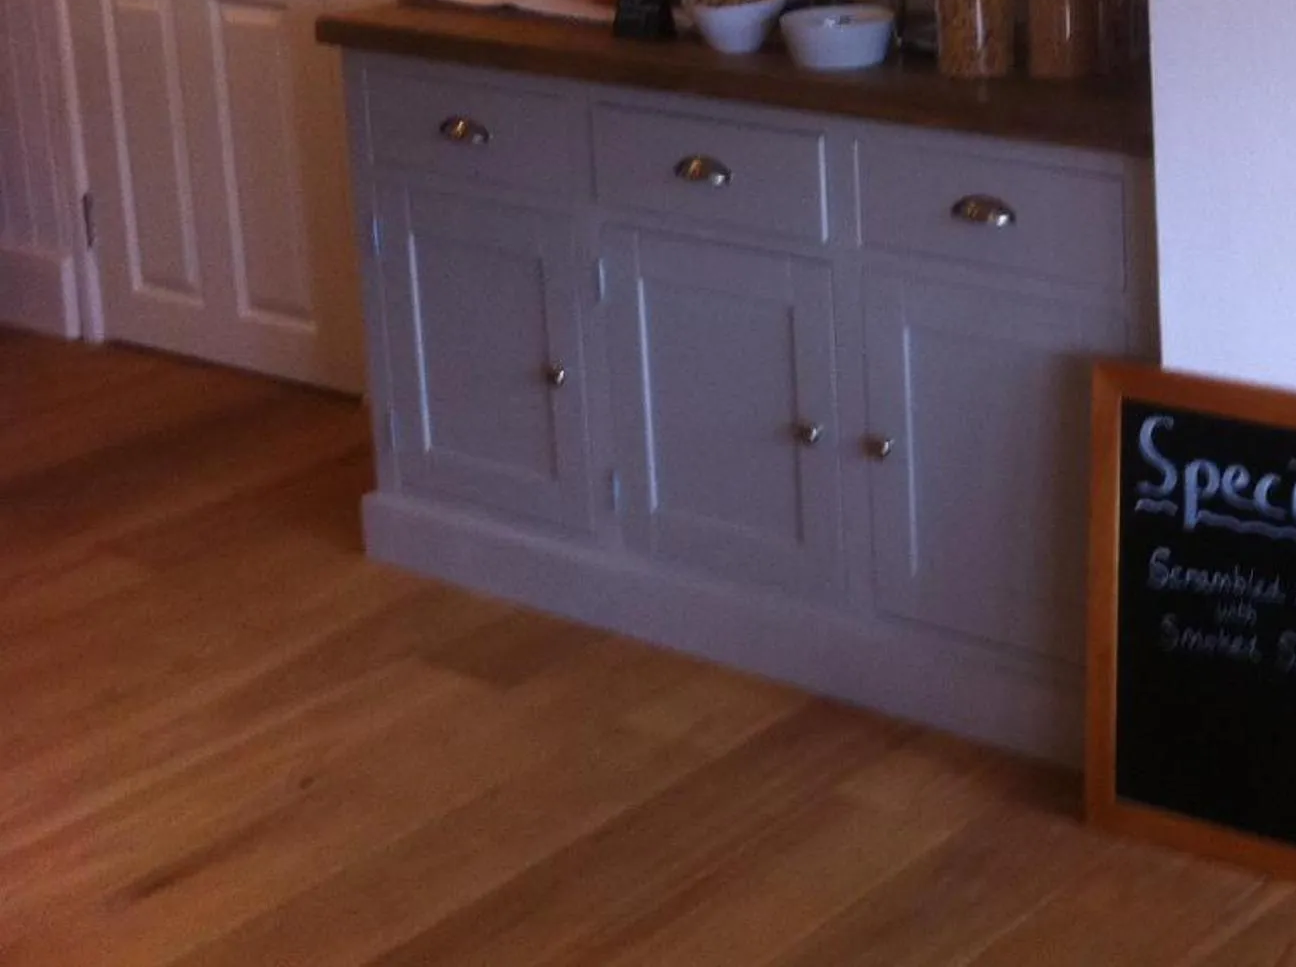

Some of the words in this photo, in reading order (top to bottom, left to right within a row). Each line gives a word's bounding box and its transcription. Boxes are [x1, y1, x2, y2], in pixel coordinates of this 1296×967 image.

[1147, 545, 1286, 604] Scrambled
[1216, 598, 1258, 627] with
[1160, 613, 1262, 663] Smoked
